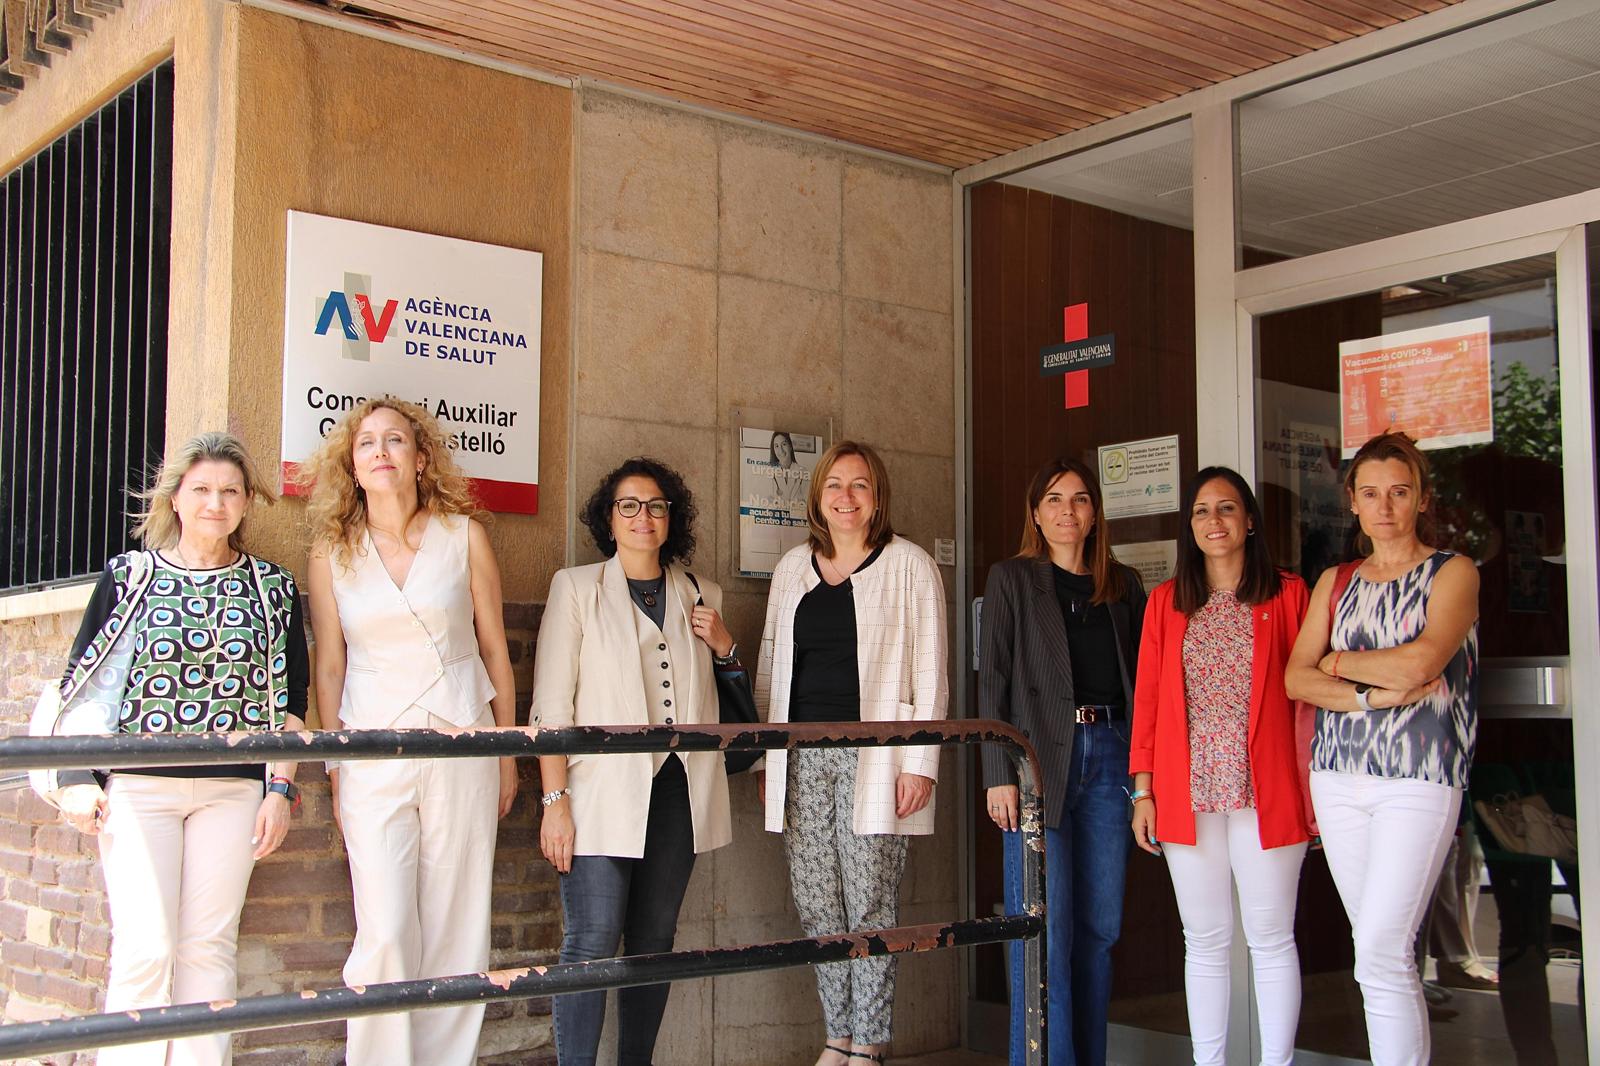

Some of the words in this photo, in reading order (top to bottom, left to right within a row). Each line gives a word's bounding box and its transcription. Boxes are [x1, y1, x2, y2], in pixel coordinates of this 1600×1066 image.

[405, 297, 492, 322] AGÈNCIA
[405, 319, 527, 349] VALENCIANA
[405, 341, 430, 358] DE
[436, 345, 497, 366] SALUT
[1048, 350, 1078, 364] GENERALITAT
[1079, 344, 1111, 357] VALENCIANA
[1345, 354, 1389, 367] Vacunació
[1391, 347, 1433, 360] COVID-19
[435, 399, 518, 427] Auxiliar
[752, 465, 810, 481] urgencia
[749, 509, 773, 517] acude
[781, 510, 790, 518] tu
[755, 517, 780, 525] centro
